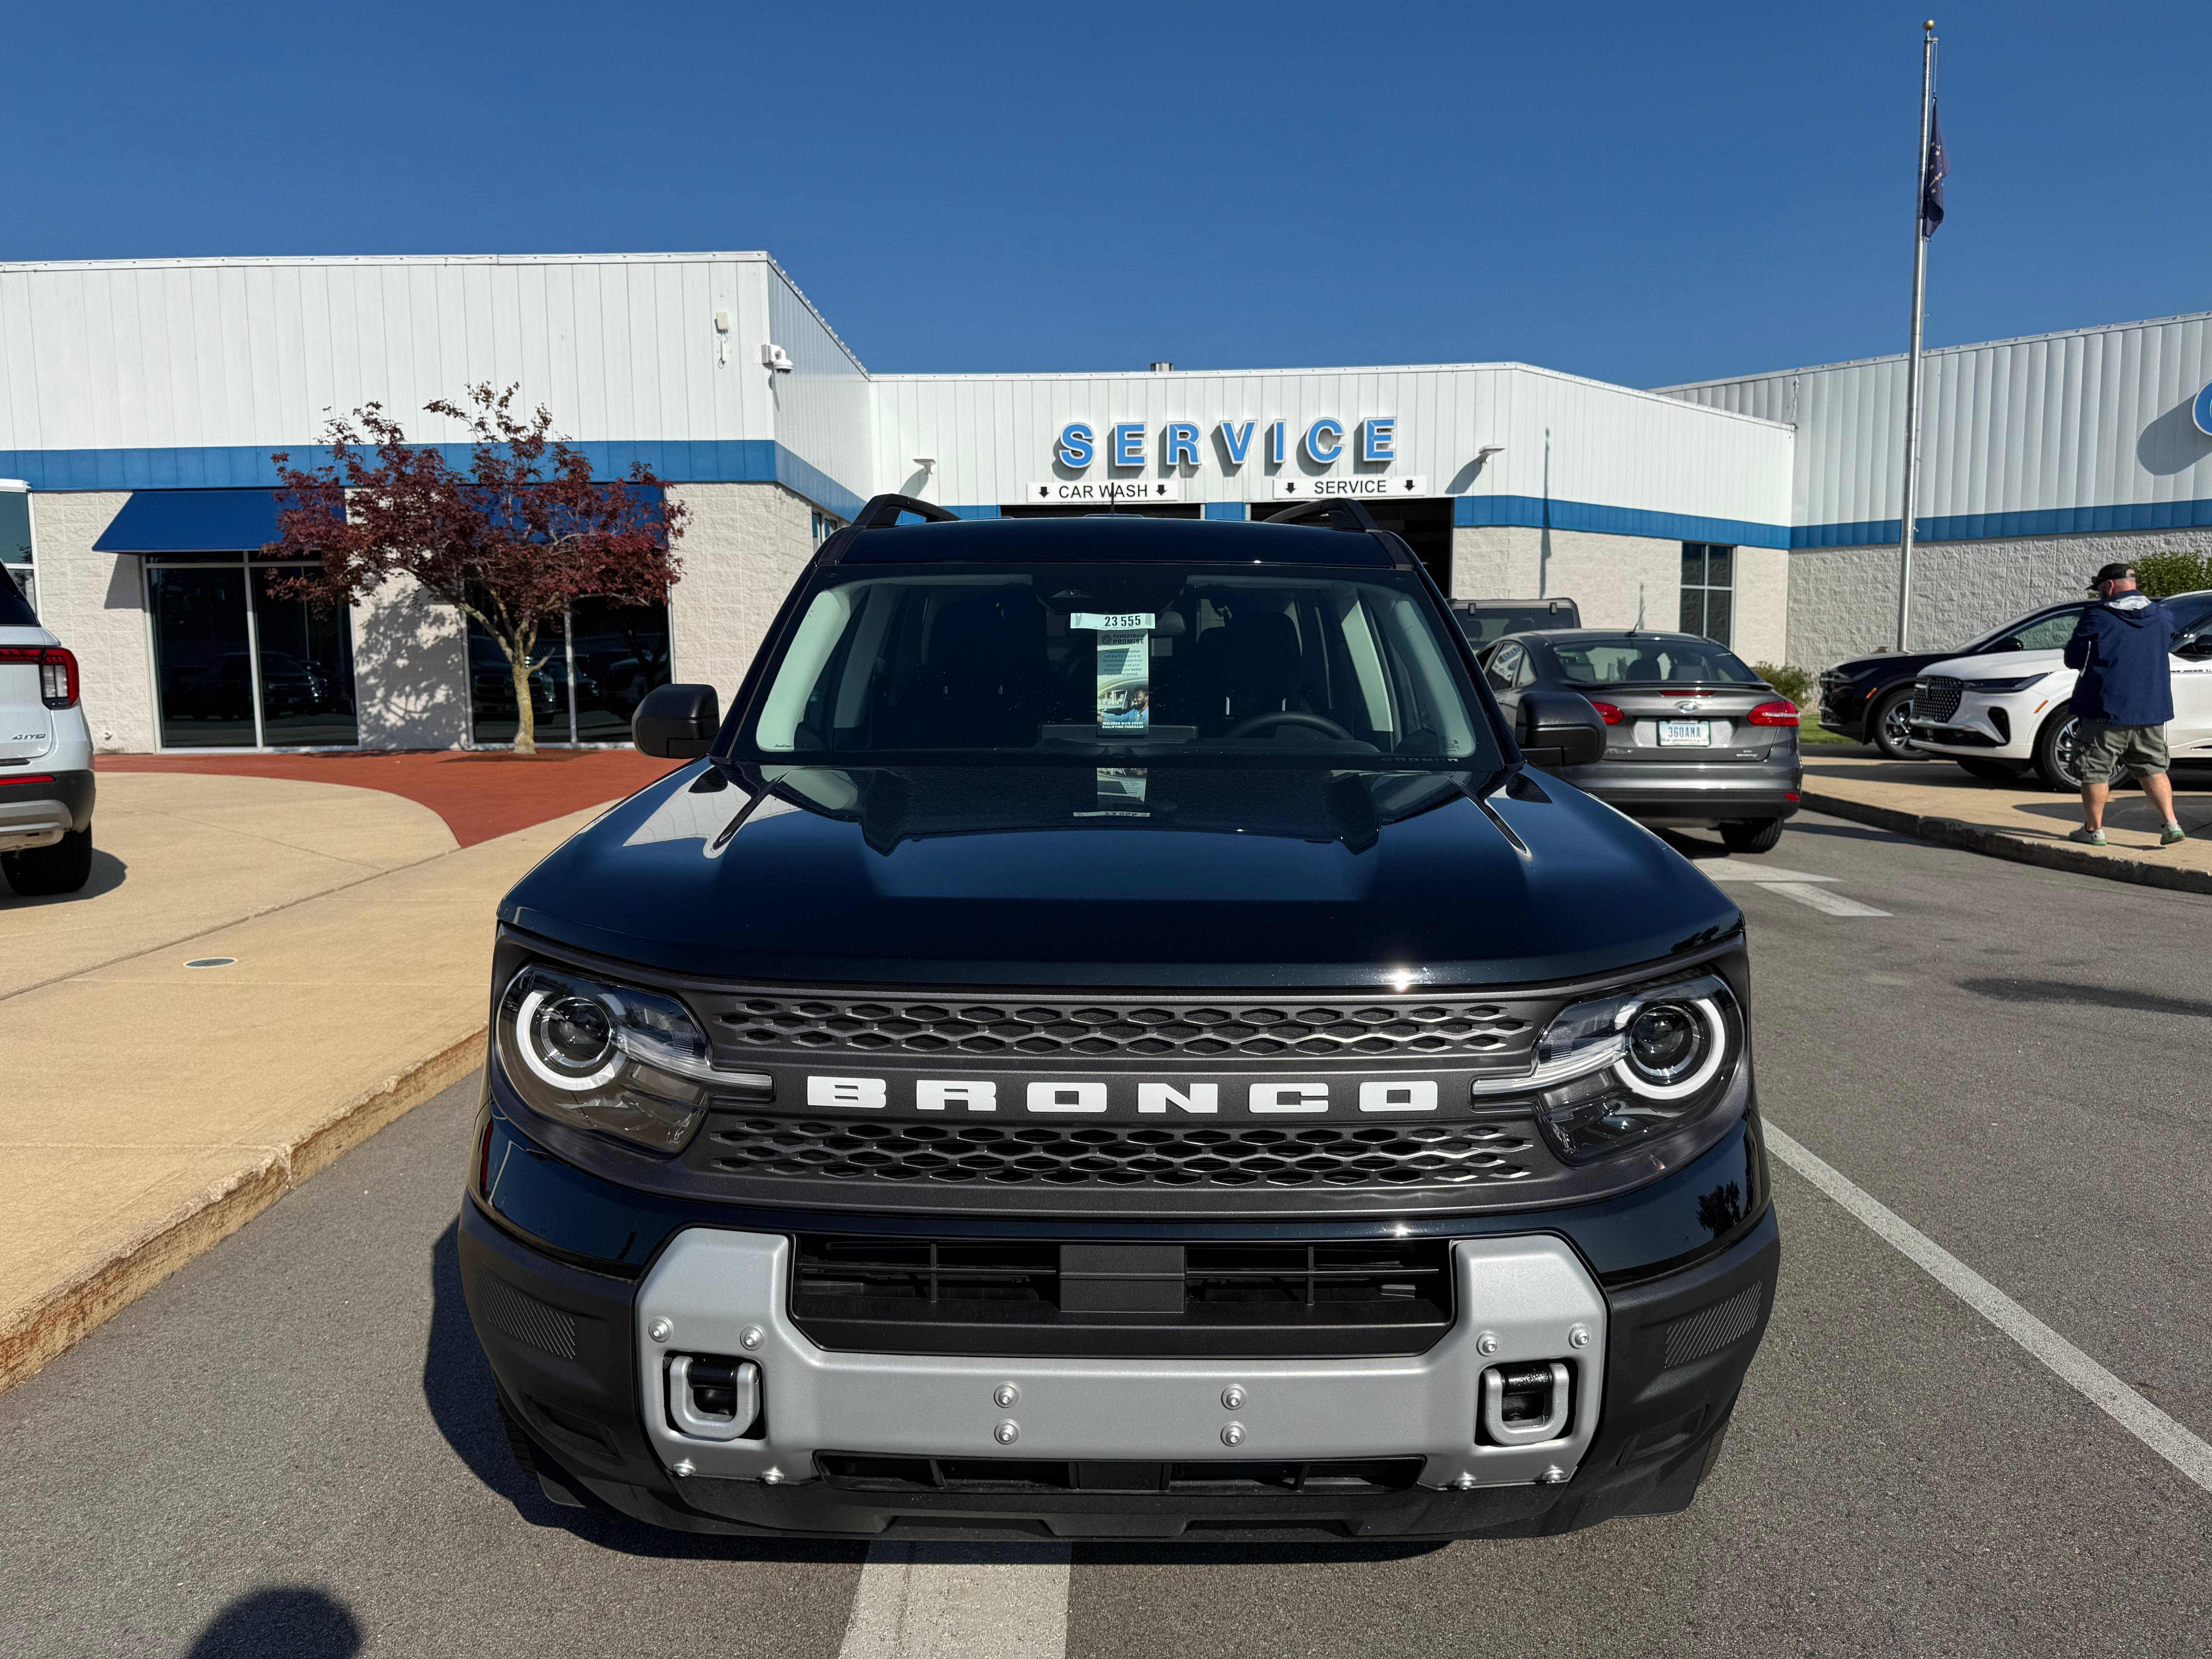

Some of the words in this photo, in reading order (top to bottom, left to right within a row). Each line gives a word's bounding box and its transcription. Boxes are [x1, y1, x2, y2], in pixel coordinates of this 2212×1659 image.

[1059, 417, 1396, 468] SERVICE
[1059, 485, 1093, 498] CAR
[1099, 484, 1147, 498] WASH
[1314, 480, 1387, 494] SERVICE
[807, 1075, 1438, 1113] BRONCO
